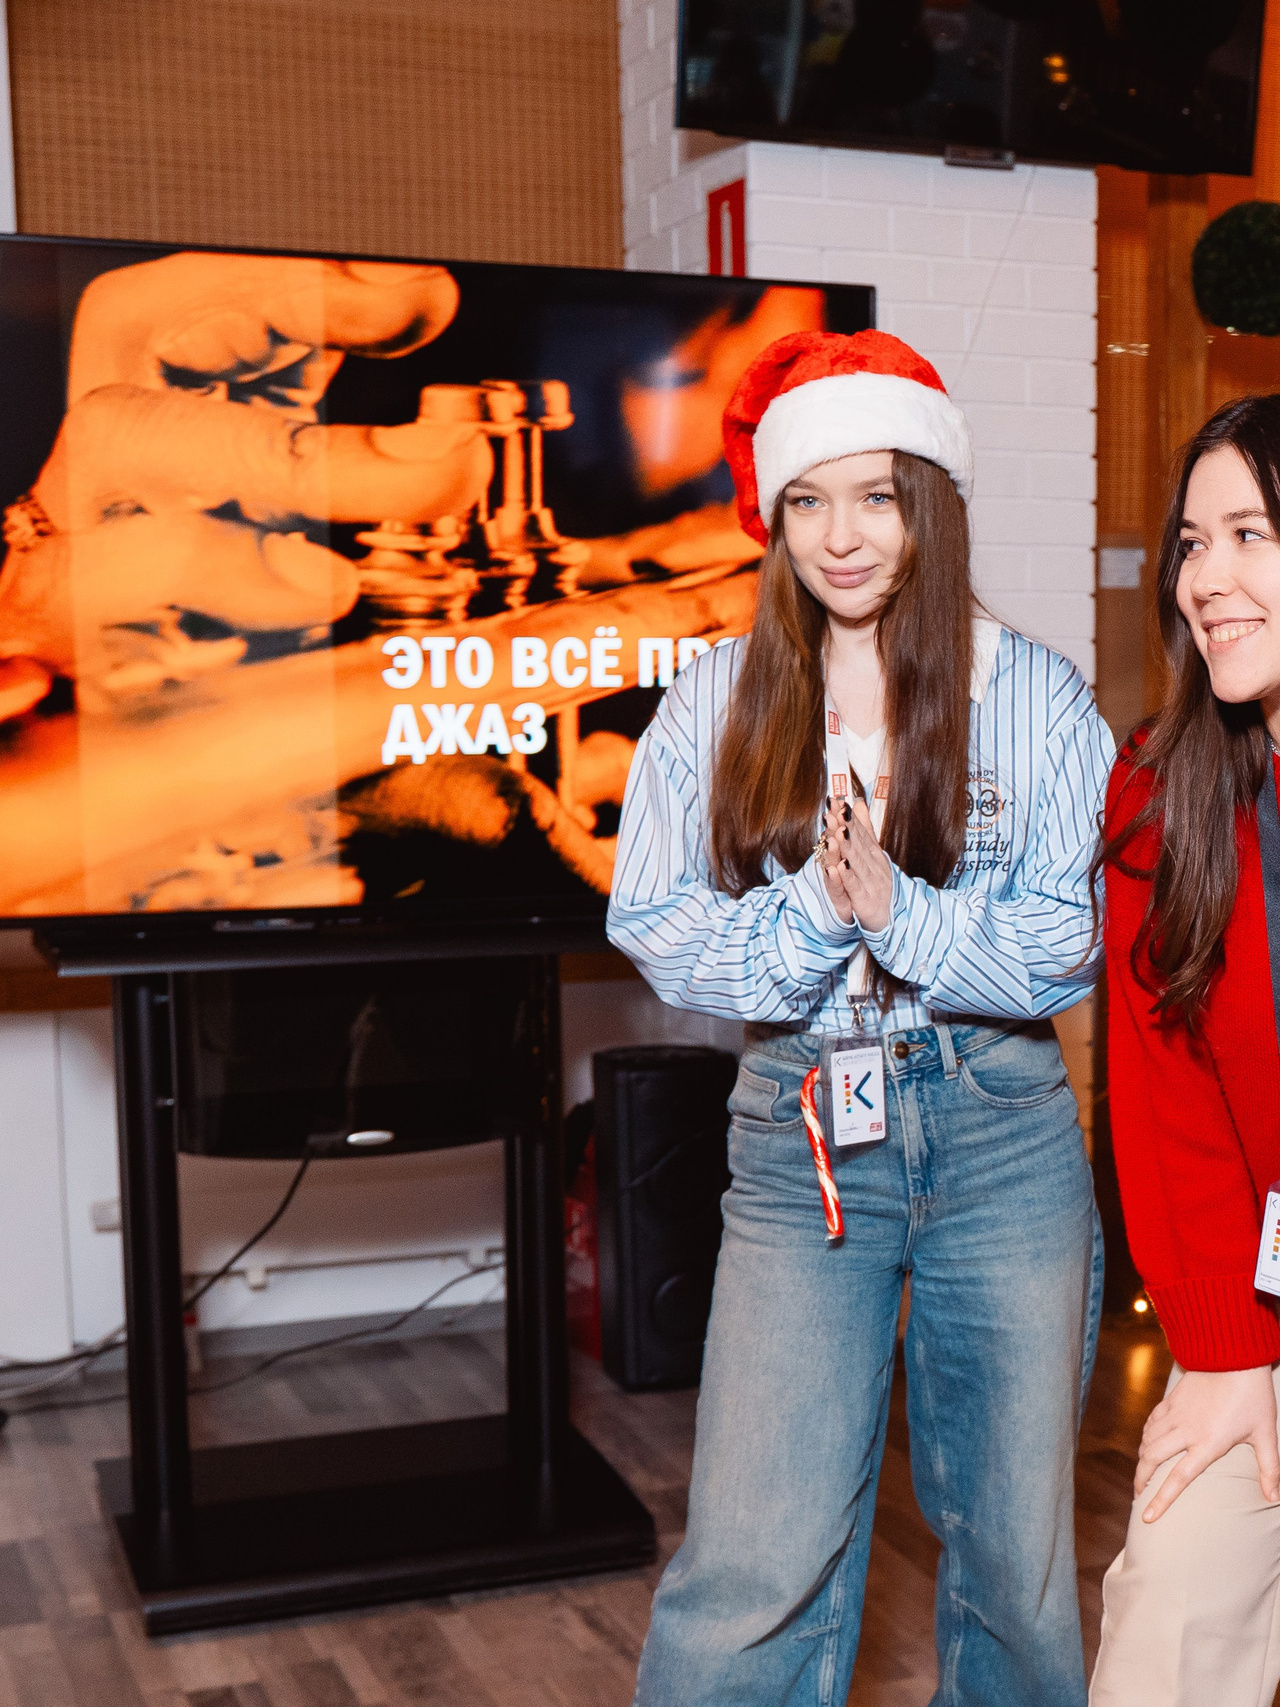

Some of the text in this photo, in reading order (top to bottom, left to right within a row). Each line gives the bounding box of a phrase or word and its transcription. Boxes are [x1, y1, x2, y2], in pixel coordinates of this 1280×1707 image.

[381, 625, 737, 689] ЭТО ВСЁ ПР
[381, 701, 548, 765] ДЖАЗ
[968, 769, 995, 777] UNDY
[963, 832, 1011, 859] undy
[954, 859, 1012, 879] ystore
